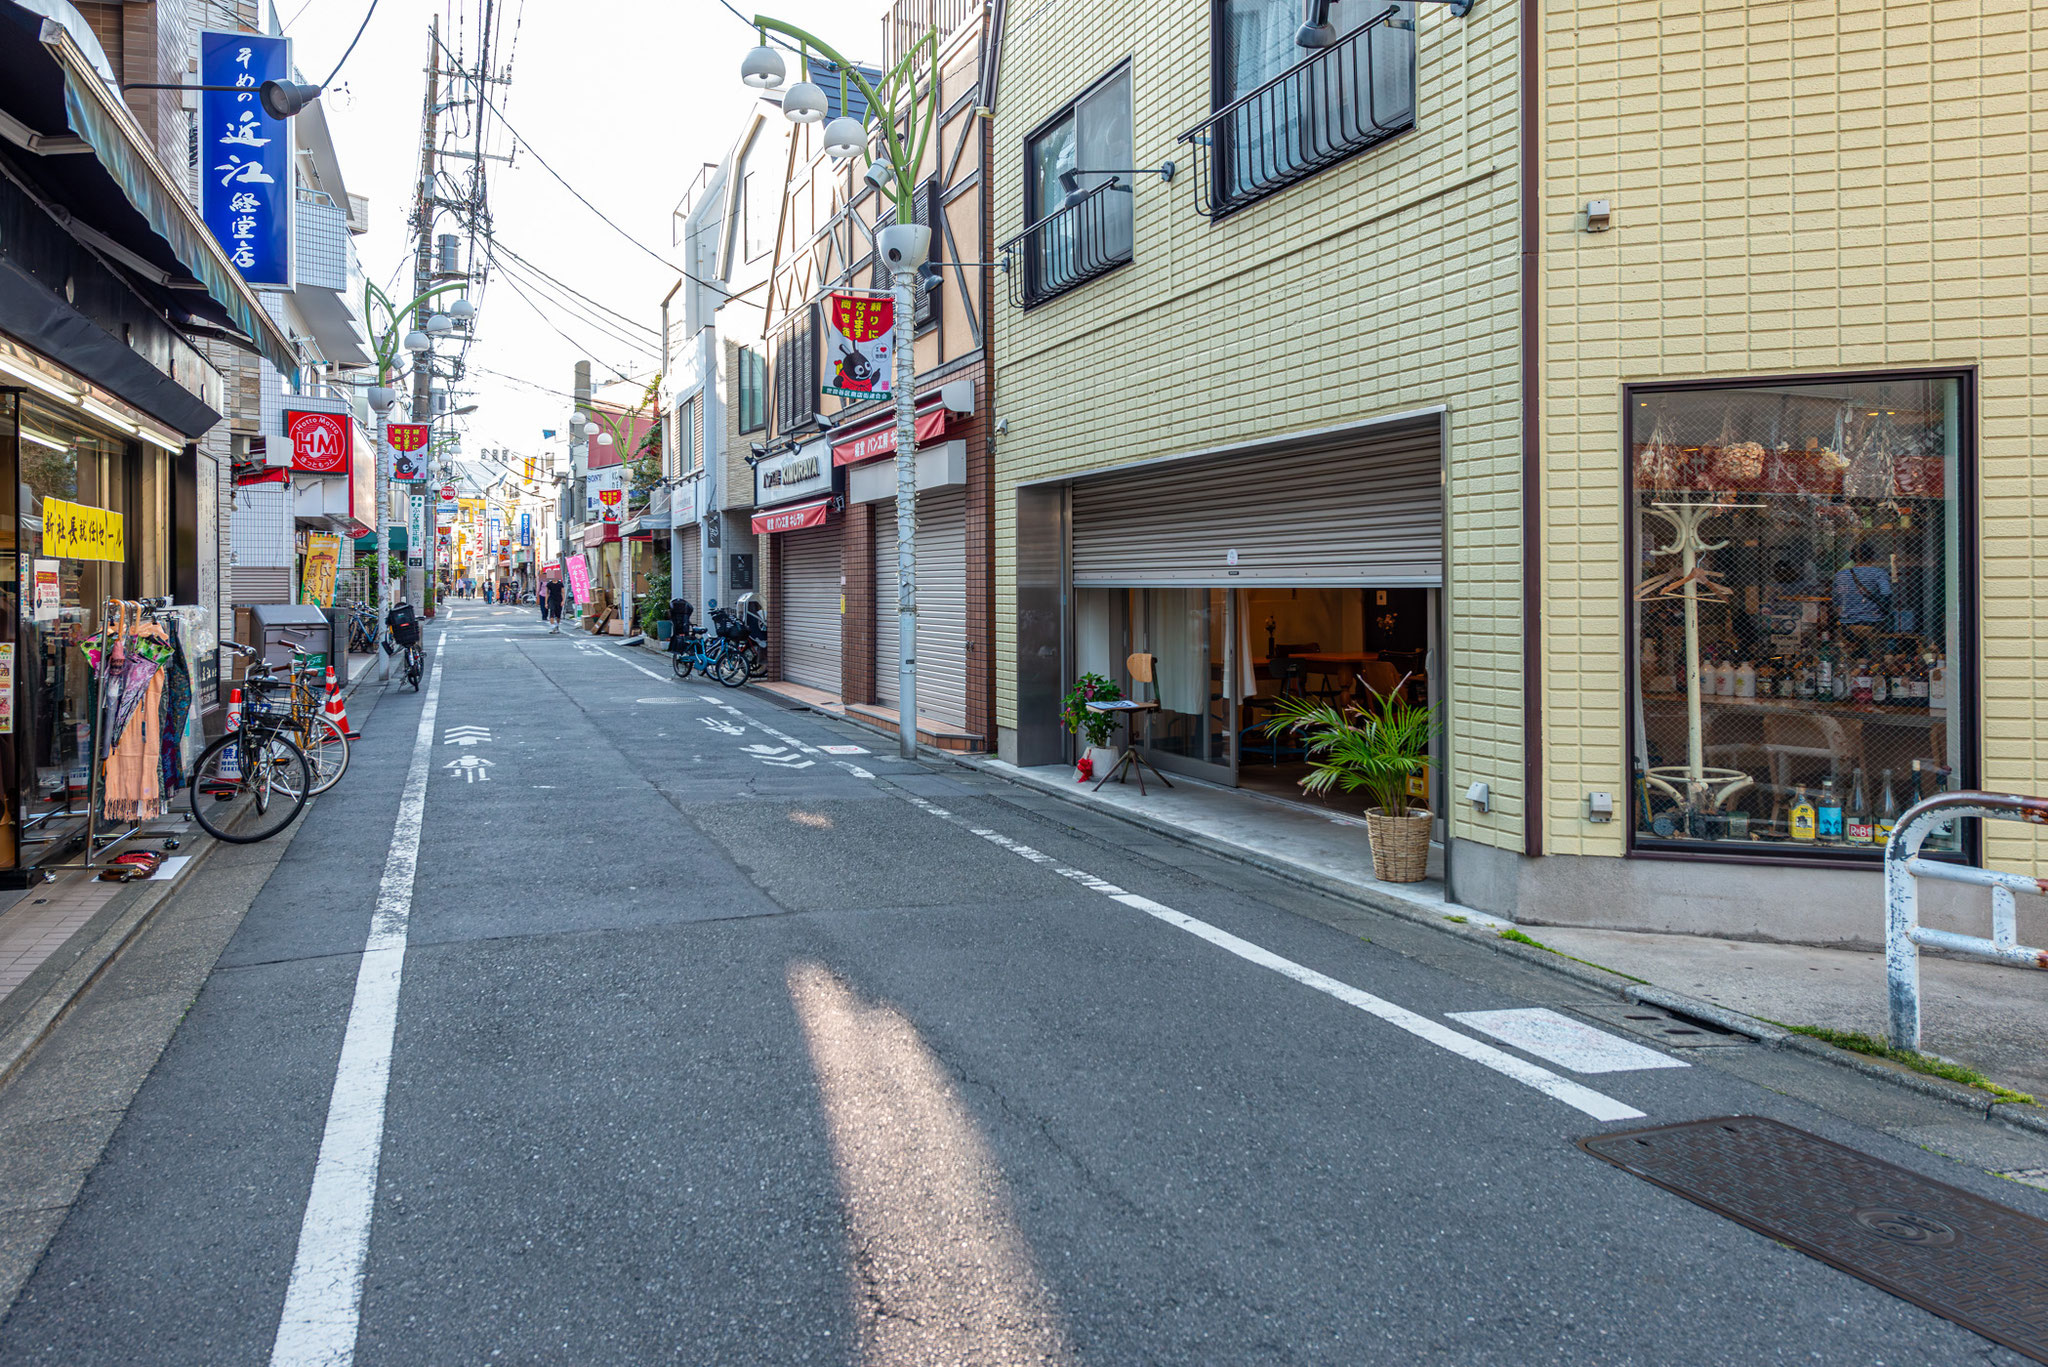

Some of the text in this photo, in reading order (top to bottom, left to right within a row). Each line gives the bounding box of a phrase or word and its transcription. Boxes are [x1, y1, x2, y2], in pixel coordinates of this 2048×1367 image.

[841, 299, 852, 338] 商店街
[853, 301, 866, 339] なります
[868, 302, 882, 340] 頼りに
[297, 417, 339, 435] Hotto Motto
[296, 431, 339, 455] HM
[867, 432, 889, 454] パン工房
[300, 456, 335, 468] ほっともっと
[587, 473, 602, 483] SONY
[45, 510, 122, 548] 新社長就任セール
